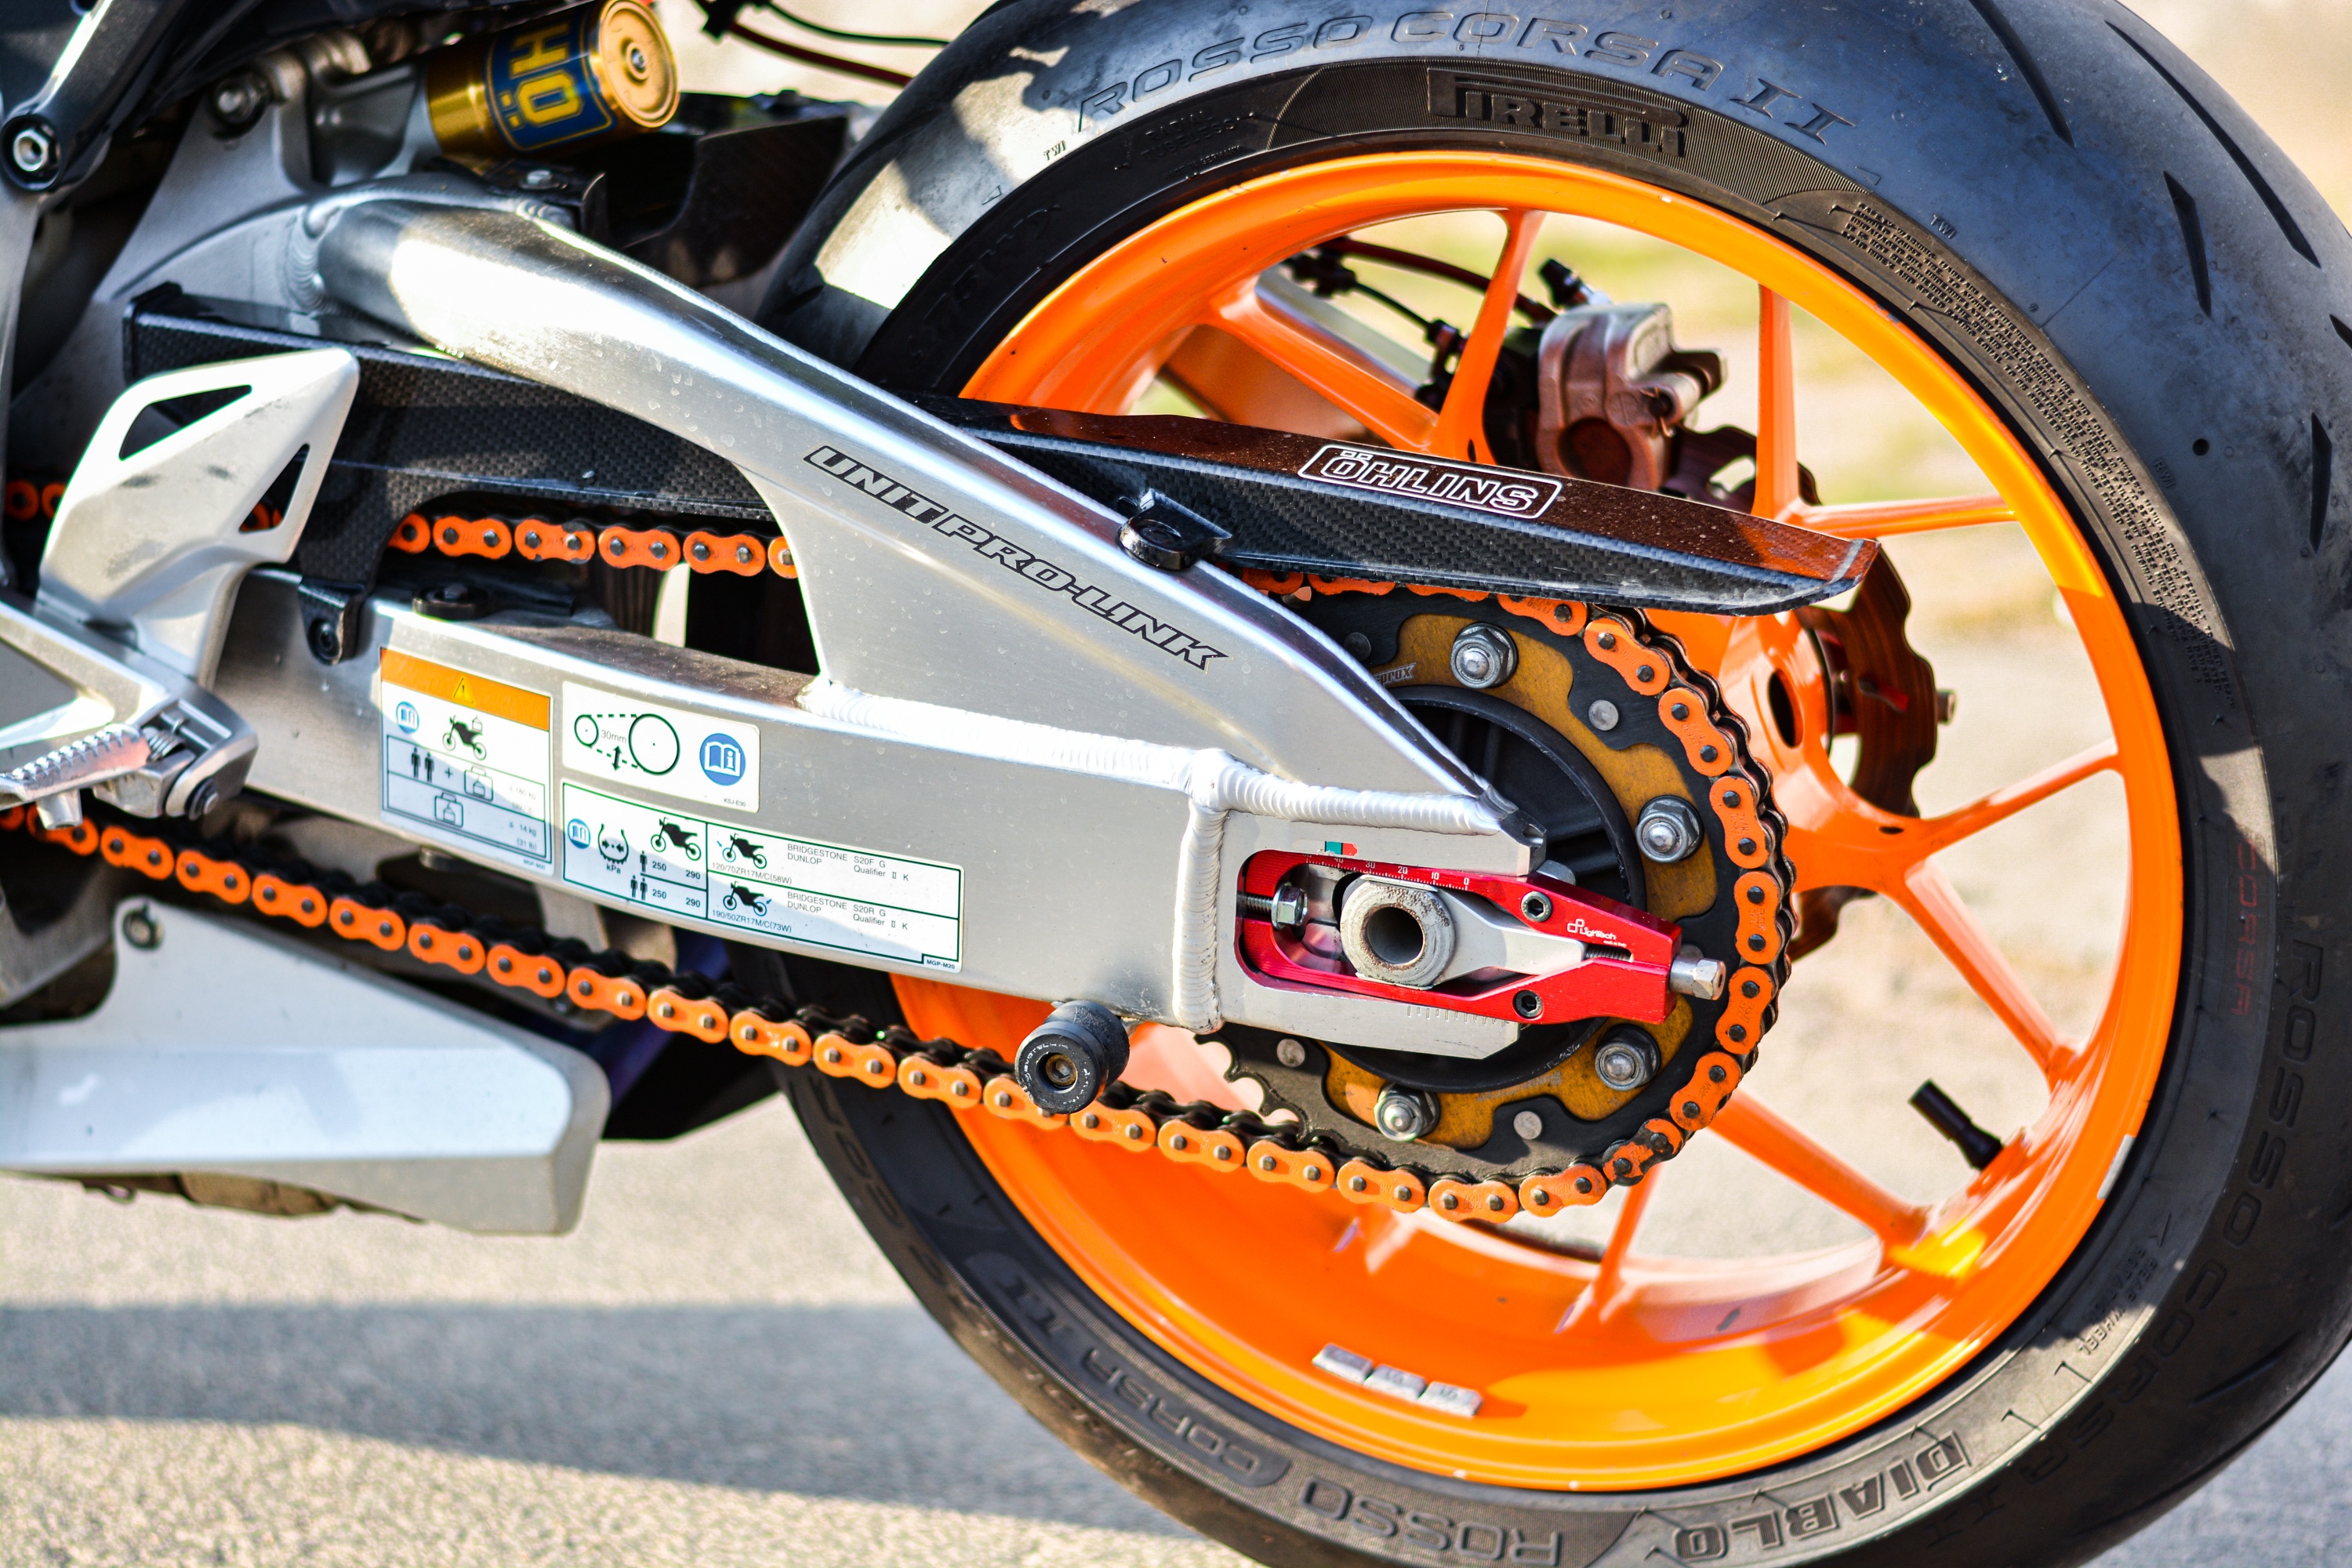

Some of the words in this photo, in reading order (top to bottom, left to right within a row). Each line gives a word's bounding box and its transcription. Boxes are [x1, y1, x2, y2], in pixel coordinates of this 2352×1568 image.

[1077, 15, 1374, 133] ROSSO
[1391, 12, 1723, 92] CORSA
[1730, 78, 1857, 146] II
[1427, 67, 1686, 158] PIRELLI
[1043, 140, 1067, 162] TWI
[1929, 213, 1958, 239] TWI
[1319, 450, 1539, 512] ÖHLINS
[802, 445, 948, 524] UNIT
[932, 513, 1230, 670] PRO-LINK
[601, 728, 627, 743] 30mm
[723, 797, 746, 808] KSJ-E30
[517, 837, 527, 847] (31
[520, 824, 527, 833] 14
[529, 827, 537, 837] kg
[787, 844, 848, 862] BRIDGESTONE
[854, 855, 875, 866] S20F
[787, 853, 822, 866] DUNLOP
[853, 865, 886, 877] Qualifier
[605, 863, 622, 875] kPa
[652, 861, 667, 872] 250
[685, 869, 701, 880] 290
[712, 862, 792, 885] 120/70ZR17M/C(58W)
[1365, 861, 1376, 869] 30
[1397, 866, 1408, 875] 20
[1431, 872, 1439, 880] 10
[1463, 877, 1470, 886] 0
[652, 888, 667, 899] 250
[685, 898, 701, 909] 290
[787, 892, 848, 910] BRIDGESTONE
[853, 904, 875, 915] S20R
[712, 909, 792, 933] 190/50ZR17M/C(73W)
[787, 901, 822, 913] DUNLOP
[853, 913, 884, 926] Qualifier
[2230, 838, 2259, 1018] CORSA
[926, 959, 956, 970] MGP-M20
[2220, 938, 2325, 1248] ROSSO
[2076, 1305, 2125, 1356] WHEEL
[2020, 1258, 2228, 1485] CORSA
[1082, 1347, 1261, 1476] CORSA
[1671, 1431, 1972, 1563] DIABLO
[1298, 1476, 1561, 1567] ROSSO
